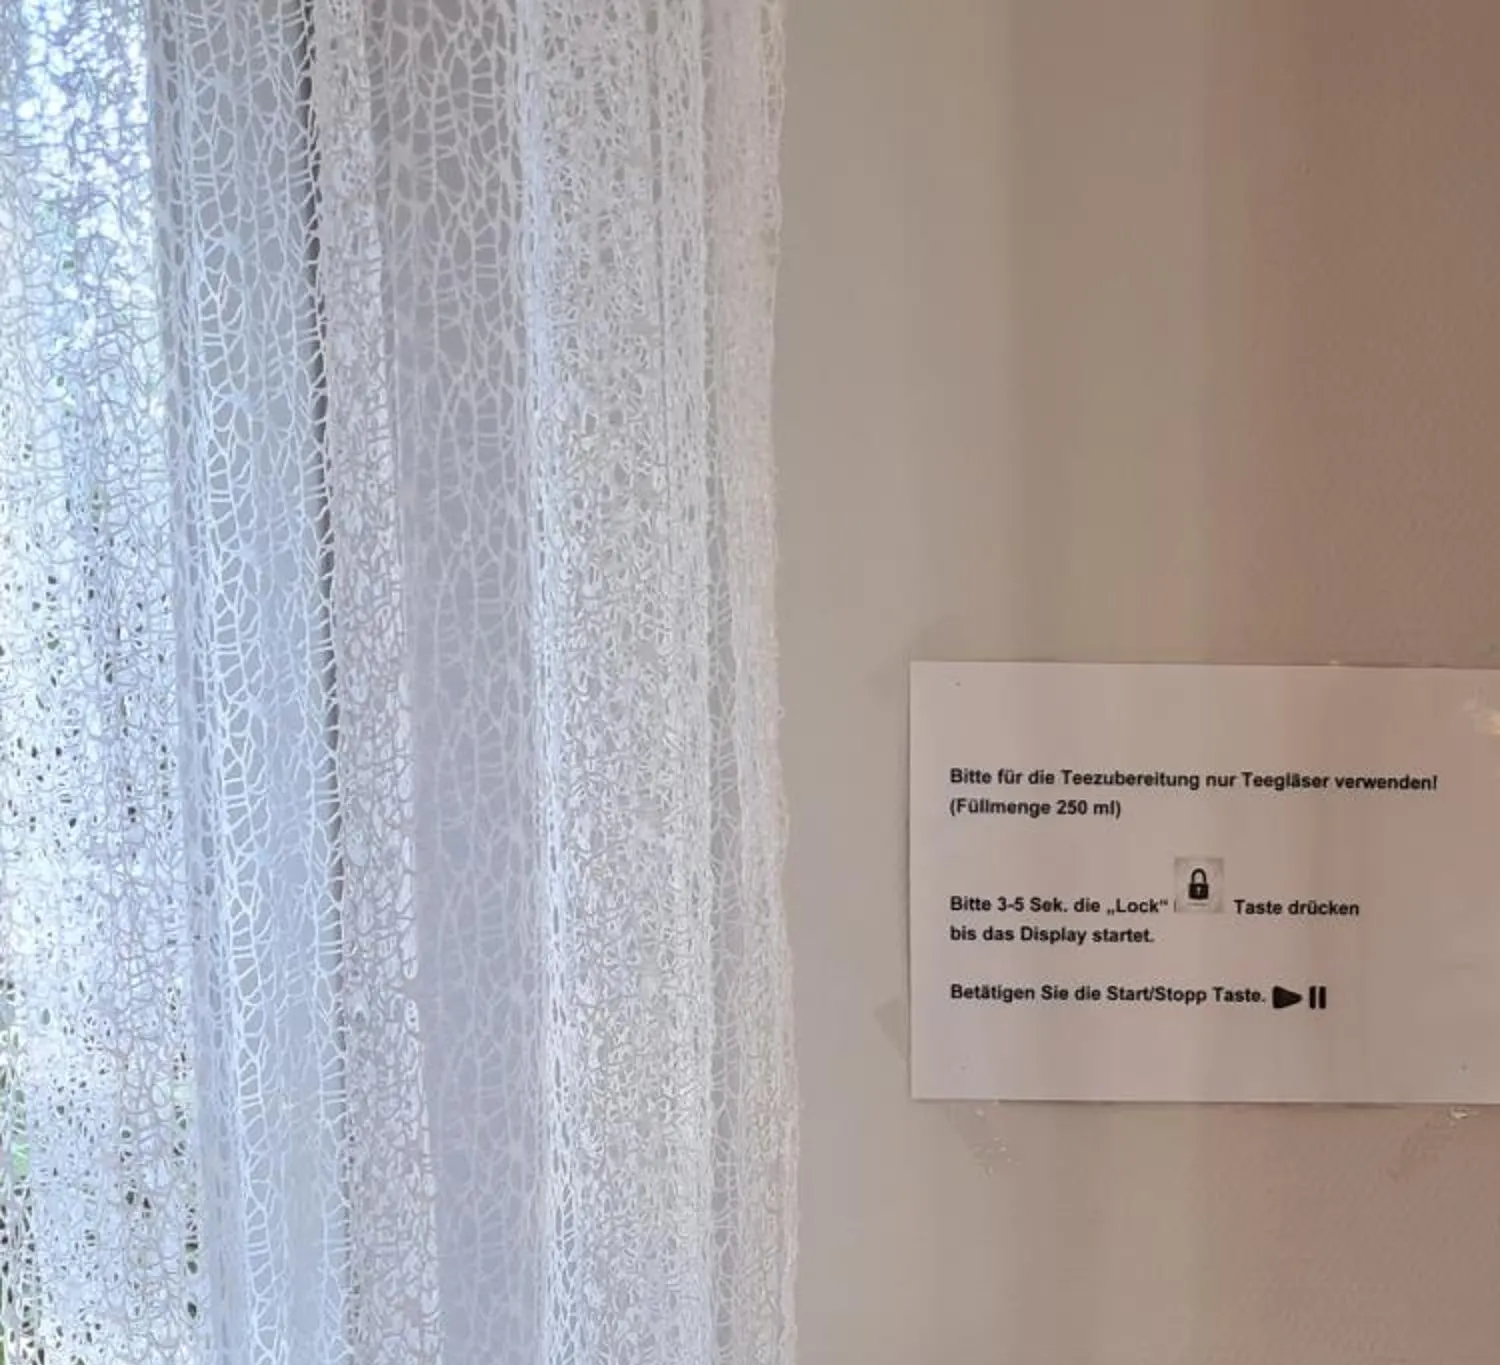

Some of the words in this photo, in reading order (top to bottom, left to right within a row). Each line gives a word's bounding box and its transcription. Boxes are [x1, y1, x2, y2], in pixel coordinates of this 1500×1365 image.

[950, 767, 993, 785] Bitte
[997, 768, 1024, 785] für
[1027, 769, 1056, 785] die
[1060, 769, 1201, 791] Teezubereitung
[1205, 775, 1237, 788] nur
[1241, 771, 1331, 792] Teegläser
[1334, 773, 1438, 791] verwenden!
[949, 797, 1052, 819] (Füllmenge
[1055, 799, 1089, 816] 250
[1093, 799, 1122, 820] ml)
[950, 895, 992, 912] Bitte
[997, 895, 1025, 913] 3-5
[1029, 896, 1068, 913] Sek.
[1073, 897, 1101, 913] die
[1233, 898, 1283, 916] Taste
[1287, 899, 1360, 917] drücken
[949, 925, 978, 941] bis
[981, 925, 1016, 942] das
[1020, 925, 1088, 946] Display
[1091, 928, 1155, 943] startet.
[950, 983, 1036, 1004] Betätigen
[1040, 983, 1070, 1001] Sie
[1073, 985, 1102, 1001] die
[1106, 985, 1208, 1006] Start/Stopp
[1212, 986, 1266, 1003] Taste.
